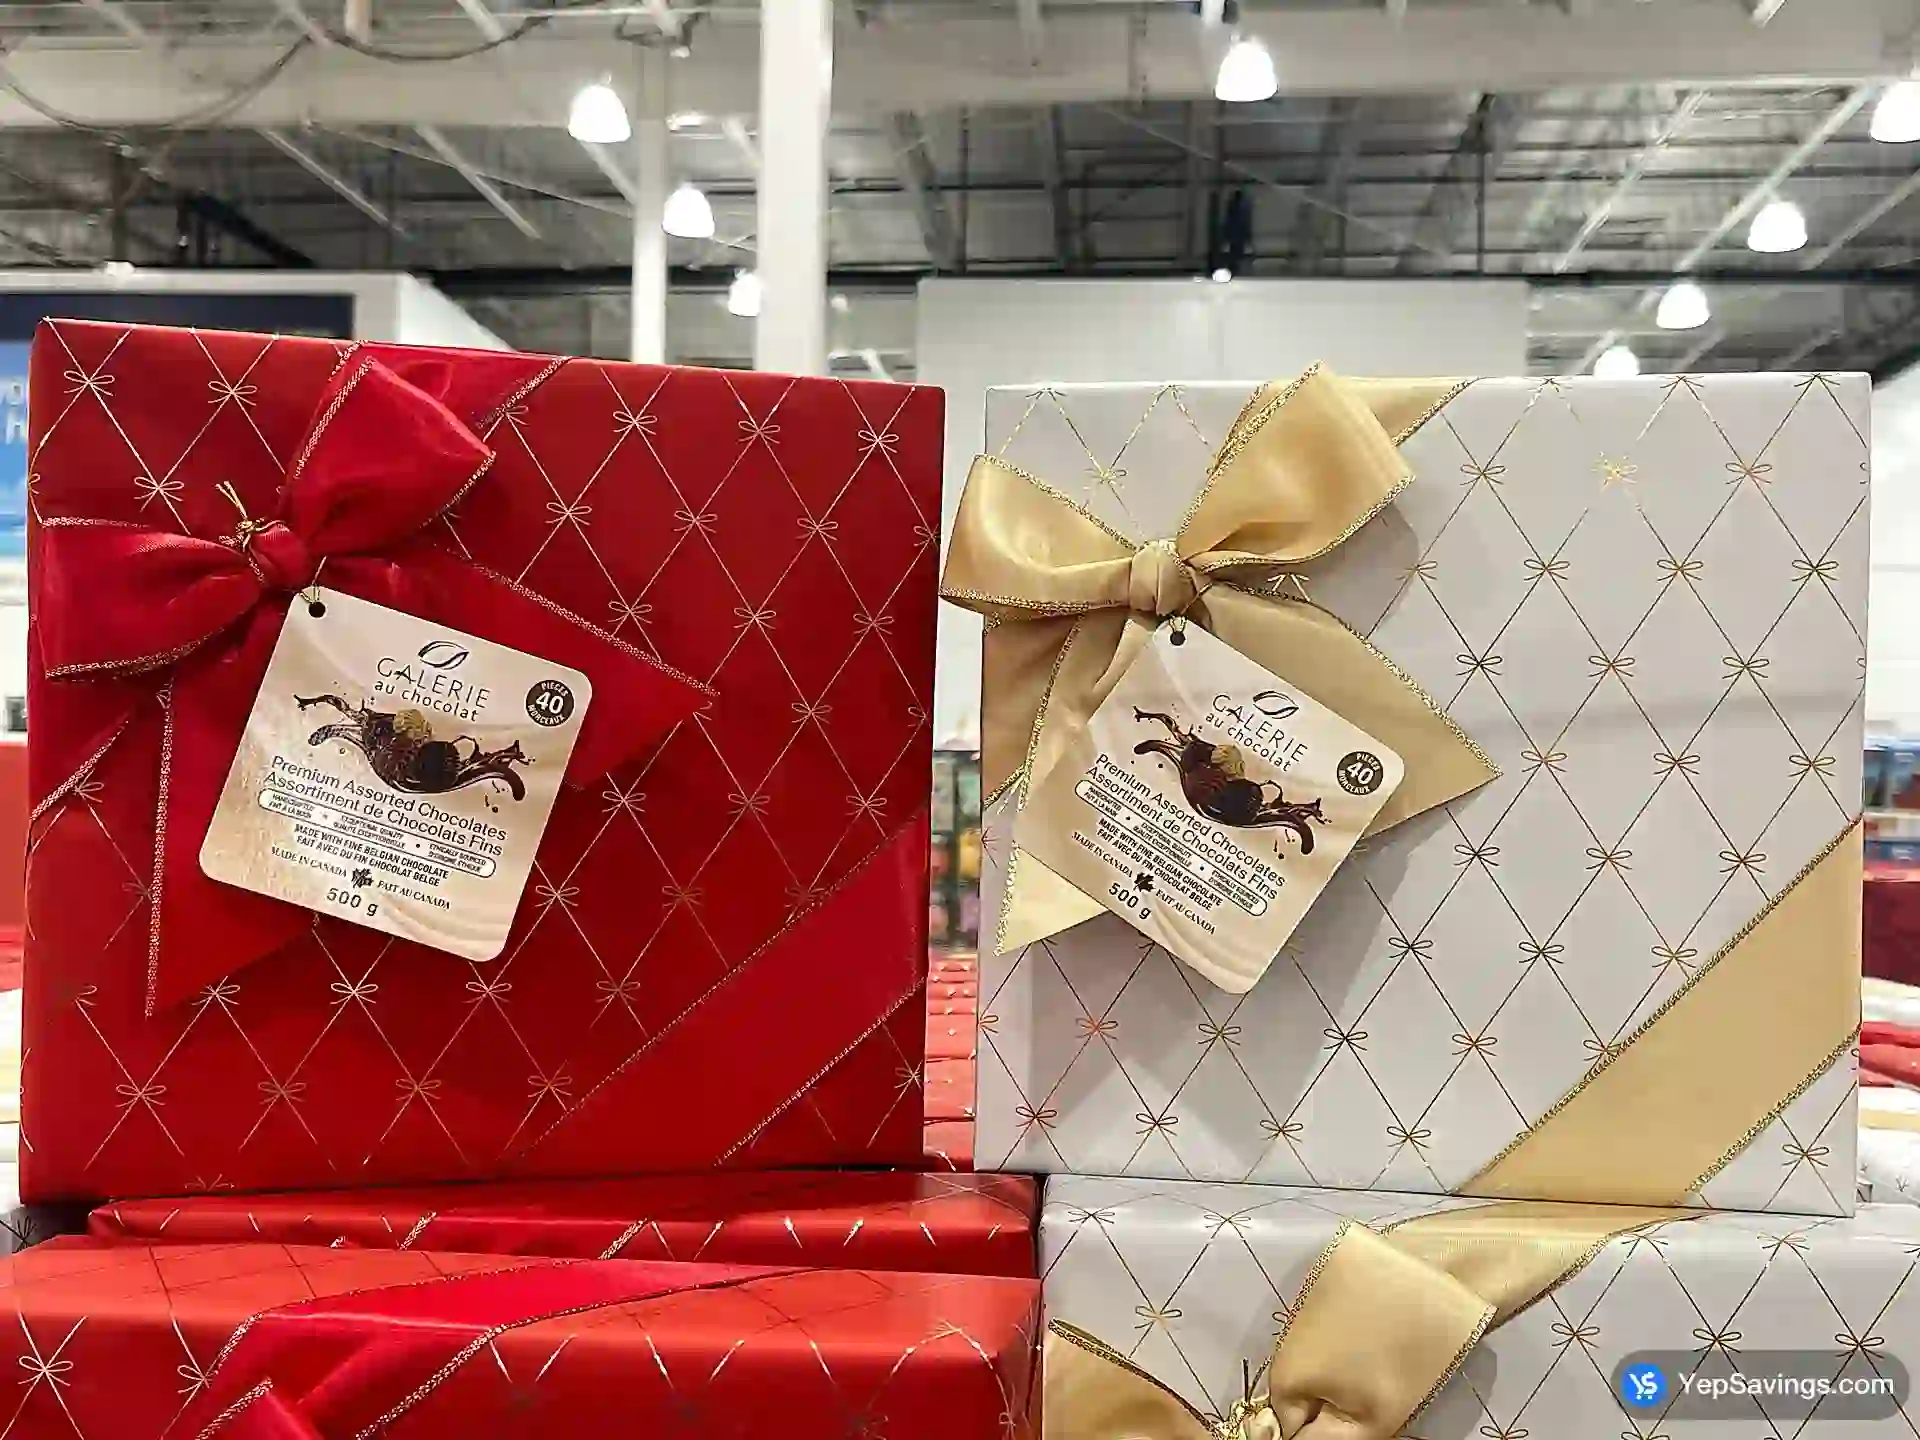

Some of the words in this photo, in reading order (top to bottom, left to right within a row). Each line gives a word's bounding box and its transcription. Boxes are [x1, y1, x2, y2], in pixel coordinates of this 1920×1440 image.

[374, 680, 395, 694] au
[401, 688, 478, 722] chocolat
[377, 657, 490, 708] GALERIE
[535, 691, 564, 714] 40
[1205, 712, 1224, 728] au
[1227, 726, 1291, 772] chocolat
[1212, 694, 1308, 762] GALERIE
[271, 755, 340, 789] Premium
[343, 779, 416, 811] Assorted
[418, 802, 506, 841] Chocolates
[1347, 761, 1374, 785] 40
[263, 771, 360, 811] Assortiment
[363, 803, 383, 818] de
[387, 809, 466, 844] Chocolats
[468, 834, 502, 856] Fins
[1085, 766, 1163, 822] Assortiment
[1162, 819, 1180, 834] de
[1181, 829, 1247, 879] Chocolats
[1247, 873, 1277, 899] Fins
[1095, 753, 1151, 797] Premium
[1150, 792, 1212, 836] Assorted
[1211, 831, 1285, 887] Chocolates
[271, 846, 296, 861] MADE
[298, 855, 309, 864] IN
[310, 859, 347, 877] CANADA
[294, 823, 320, 838] MADE
[320, 831, 343, 845] WITH
[343, 839, 363, 852] FINE
[363, 846, 400, 863] BELGIAN
[400, 857, 449, 879] CHOCOLATE
[296, 835, 315, 847] FAIT
[315, 841, 339, 855] AVEC
[339, 848, 353, 859] DU
[353, 853, 368, 864] FIN
[368, 858, 412, 877] CHOCOLAT
[412, 871, 440, 887] BELGE
[1071, 831, 1095, 851] MADE
[1093, 846, 1104, 857] IN
[1102, 853, 1133, 878] CANADA
[1096, 828, 1114, 842] FAIT
[1111, 839, 1132, 855] AVEC
[1130, 851, 1143, 863] DU
[1141, 859, 1155, 871] FIN
[1154, 867, 1190, 894] CHOCOLAT
[1188, 891, 1213, 911] BELGE
[1098, 817, 1120, 836] MADE
[1119, 831, 1138, 848] WITH
[1136, 843, 1154, 859] FINE
[1152, 854, 1183, 879] BELGIAN
[1182, 875, 1223, 906] CHOCOLATE
[326, 887, 362, 908] 500
[366, 903, 378, 917] g
[376, 880, 399, 893] FAIT
[399, 887, 412, 897] AU
[413, 891, 450, 909] CANADA
[1108, 882, 1139, 908] 500
[1138, 907, 1152, 920] g
[1155, 888, 1175, 904] FAIT
[1171, 902, 1185, 912] AU
[1184, 909, 1215, 935] CANADA
